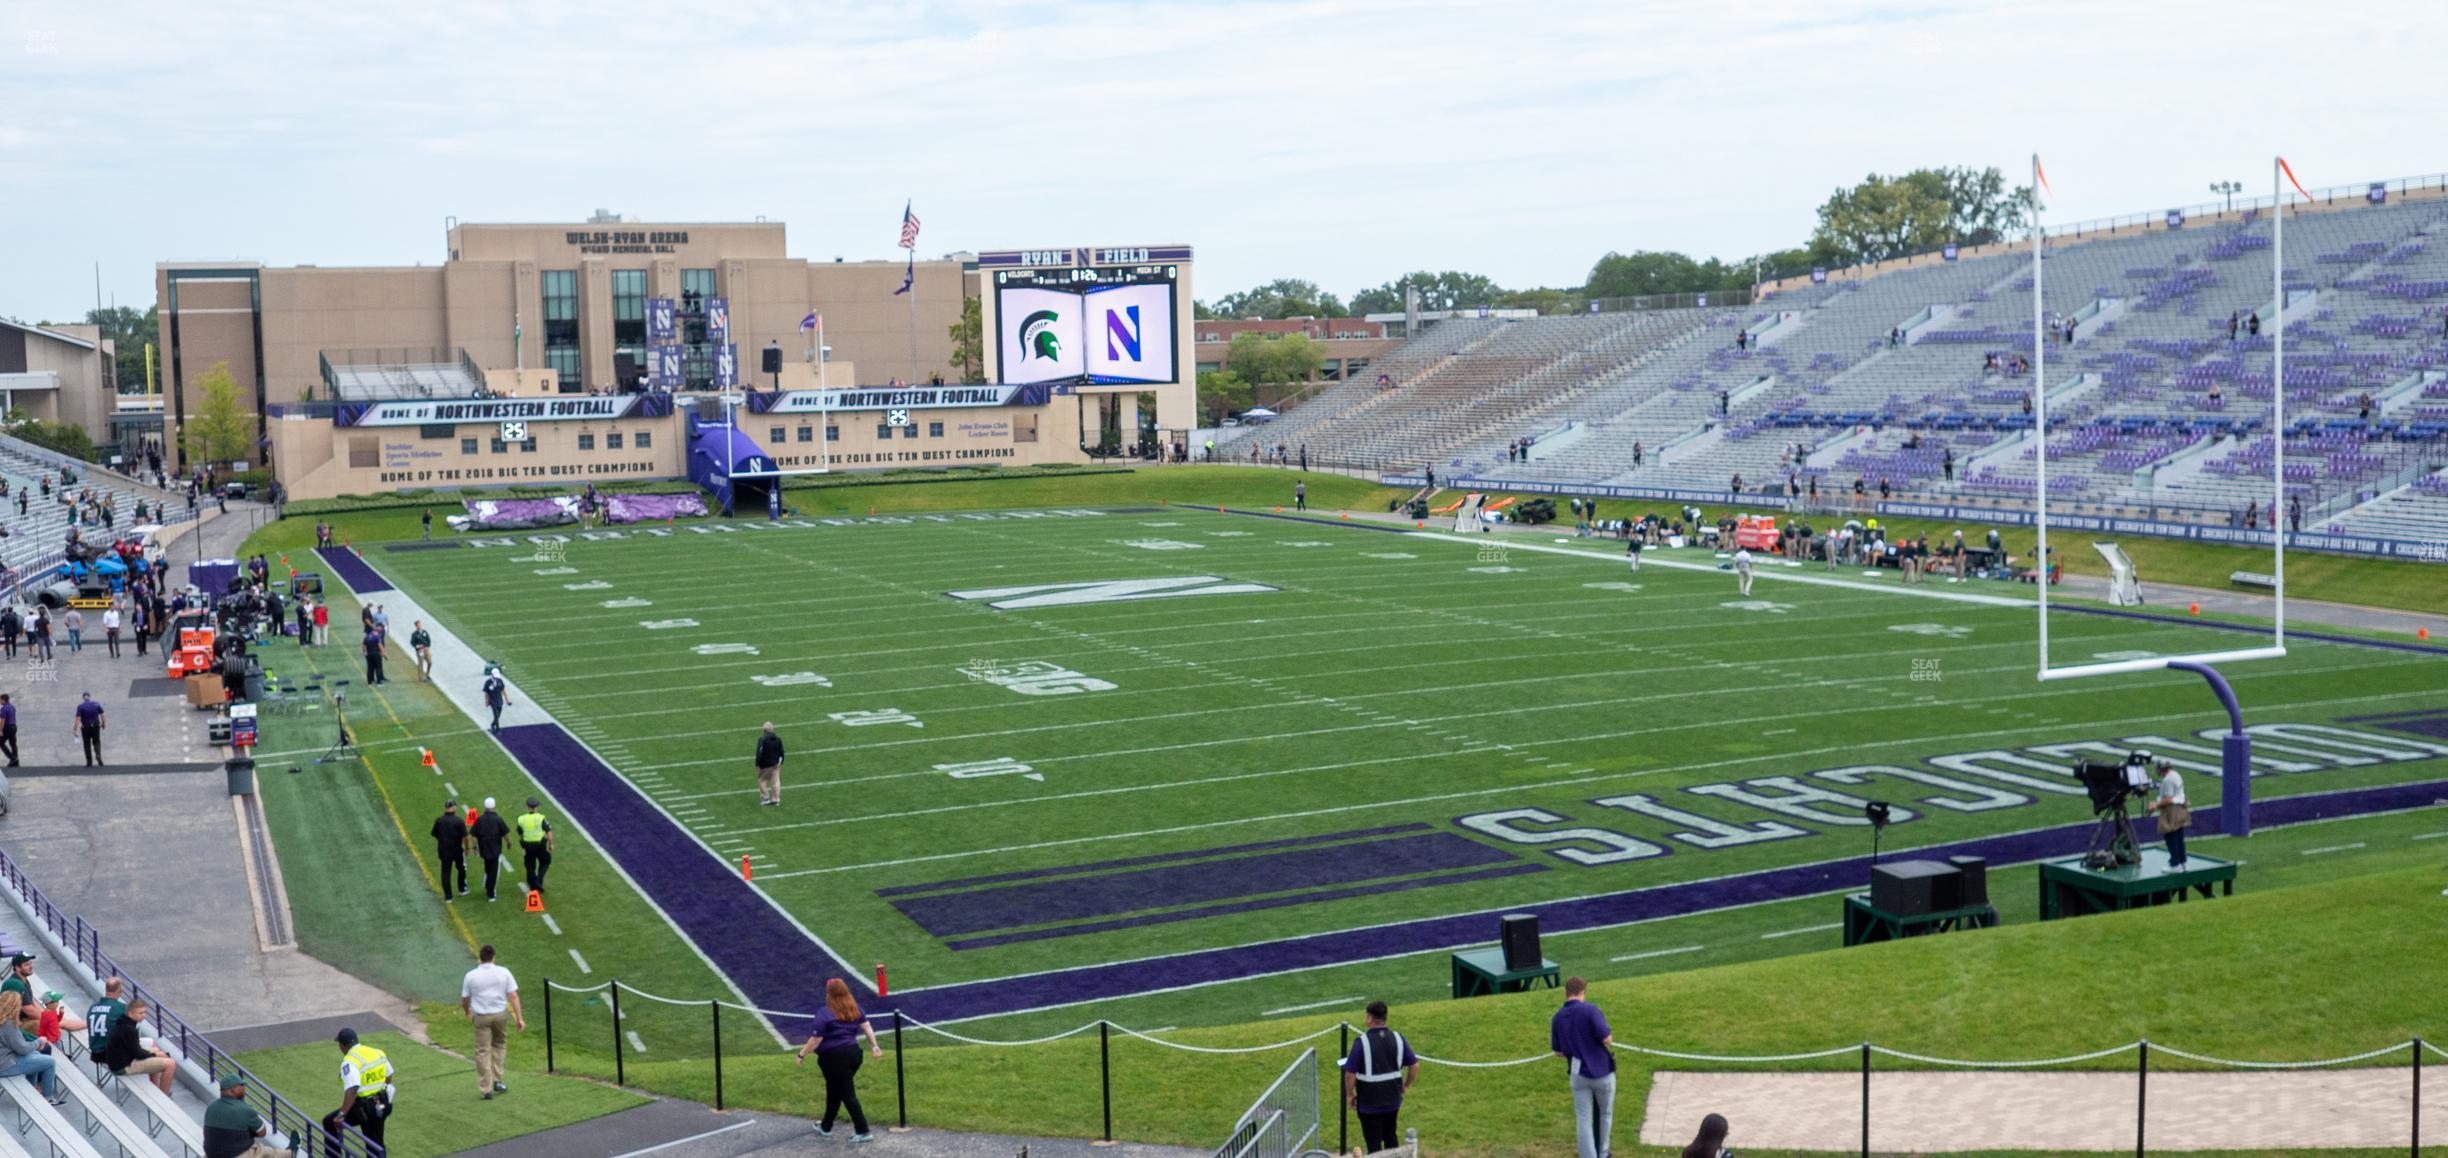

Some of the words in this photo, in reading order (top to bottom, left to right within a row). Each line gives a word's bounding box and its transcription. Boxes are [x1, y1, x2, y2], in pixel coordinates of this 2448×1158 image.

[566, 232, 645, 244] WELSH-RYAN
[650, 232, 689, 243] ARENA
[612, 245, 653, 254] MEMORIAL
[655, 245, 676, 253] HALL
[1021, 250, 1062, 266] RYAN
[1077, 248, 1090, 267] N
[1104, 248, 1148, 263] FIELD
[1000, 271, 1006, 283] 0
[1007, 270, 1035, 278] WILDCATS
[1169, 266, 1176, 278] 0
[656, 308, 670, 330] N
[711, 308, 724, 329] N
[1107, 305, 1141, 362] N
[665, 355, 679, 376] N
[719, 354, 733, 375] N
[791, 397, 817, 406] HOME
[839, 390, 937, 406] NORTHWESTERN
[941, 389, 999, 403] FOOTBALL
[381, 408, 411, 419] HOME
[416, 408, 428, 418] OF
[435, 402, 544, 419] NORTHWESTERN
[550, 399, 614, 416] FOOTBALL
[889, 410, 908, 424] 25
[504, 423, 524, 438] 25
[386, 451, 409, 460] Sports
[410, 450, 442, 458] Medicine
[804, 456, 816, 464] OF
[846, 453, 872, 462] 2018
[876, 452, 893, 462] BIG
[898, 452, 918, 461] TEN
[923, 450, 951, 460] WEST
[956, 448, 1015, 459] CHAMPIONS
[381, 471, 413, 482] HOME
[418, 470, 432, 480] OF
[438, 470, 461, 480] THE
[466, 468, 494, 478] 2018
[498, 467, 518, 478] BIG
[524, 466, 546, 476] TEN
[551, 464, 584, 475] WEST
[588, 463, 654, 474] CHAMPIONS
[387, 460, 411, 468] Center
[750, 458, 762, 472] N
[529, 895, 538, 907] G
[89, 1014, 108, 1036] 14
